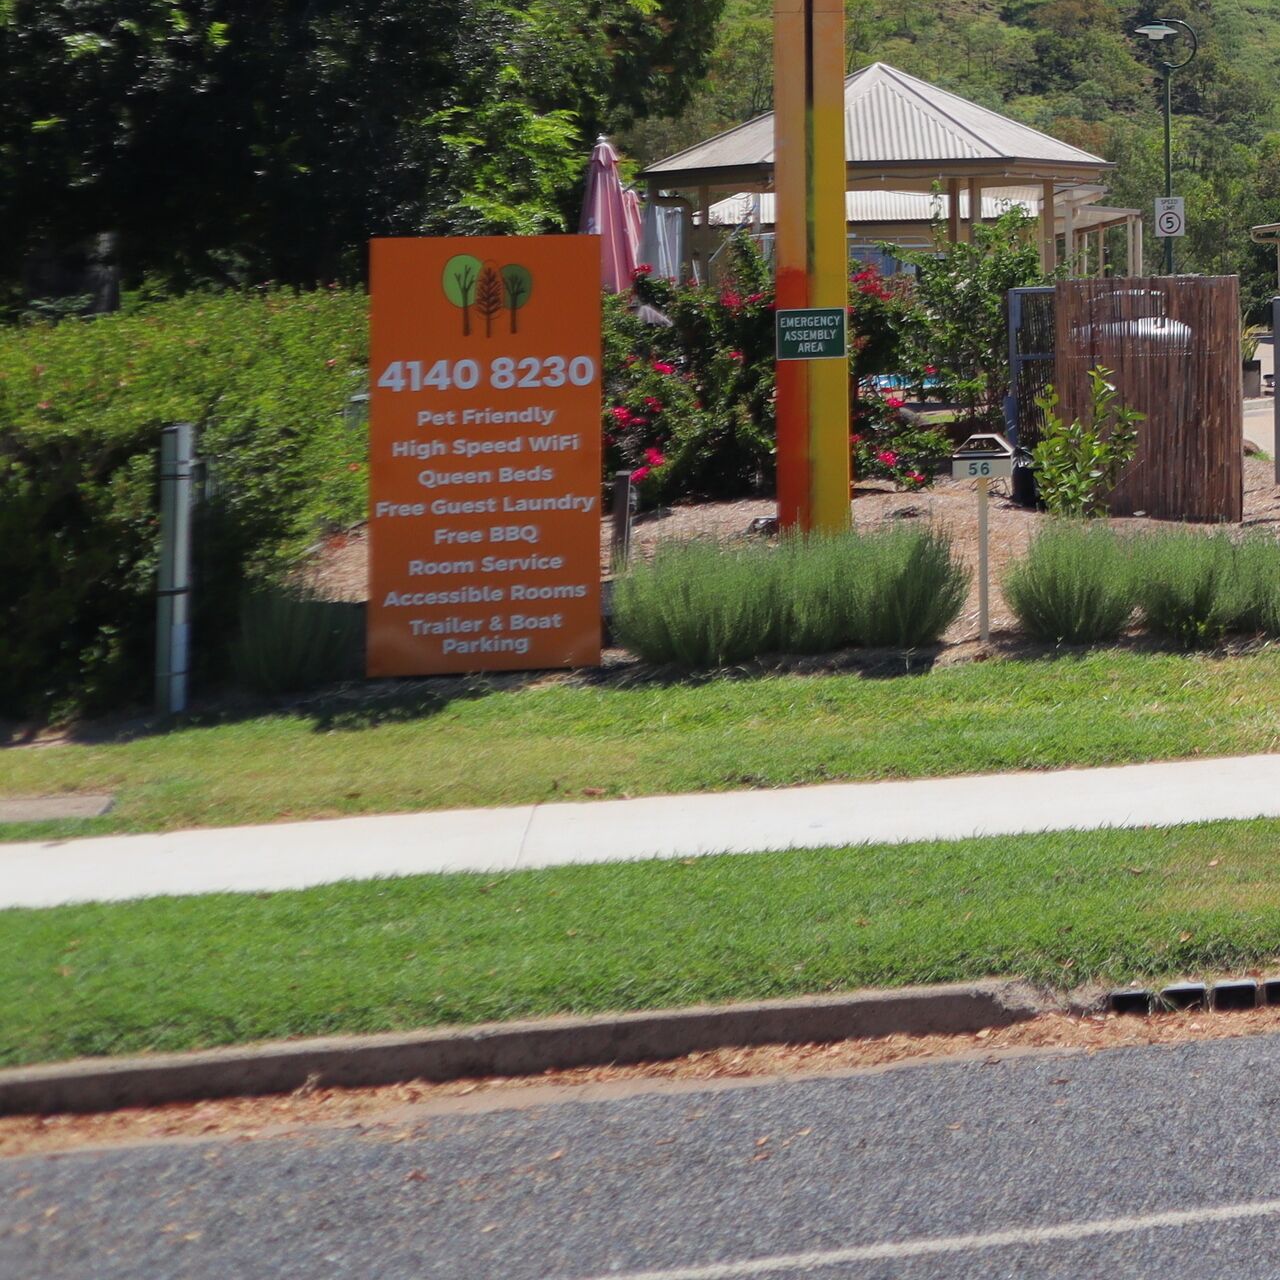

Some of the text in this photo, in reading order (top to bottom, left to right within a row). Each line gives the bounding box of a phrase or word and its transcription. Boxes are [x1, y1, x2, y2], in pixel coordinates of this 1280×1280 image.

[1166, 217, 1174, 229] 5
[780, 316, 841, 328] EMERGENCY
[784, 329, 837, 342] ASSEMBLY
[797, 342, 824, 353] AREA
[377, 355, 595, 392] 4140 8230
[417, 407, 555, 427] Pet Friendly
[392, 434, 580, 460] High Speed WiFi
[418, 465, 553, 489] Queen Beds
[968, 462, 990, 476] 56
[376, 493, 595, 518] Free Guest Laundry
[434, 525, 539, 545] Free BBQ
[408, 555, 563, 577] Room Service
[384, 583, 586, 608] Accessible Rooms
[410, 613, 562, 636] Trailer & Boat
[443, 635, 530, 657] Parking
